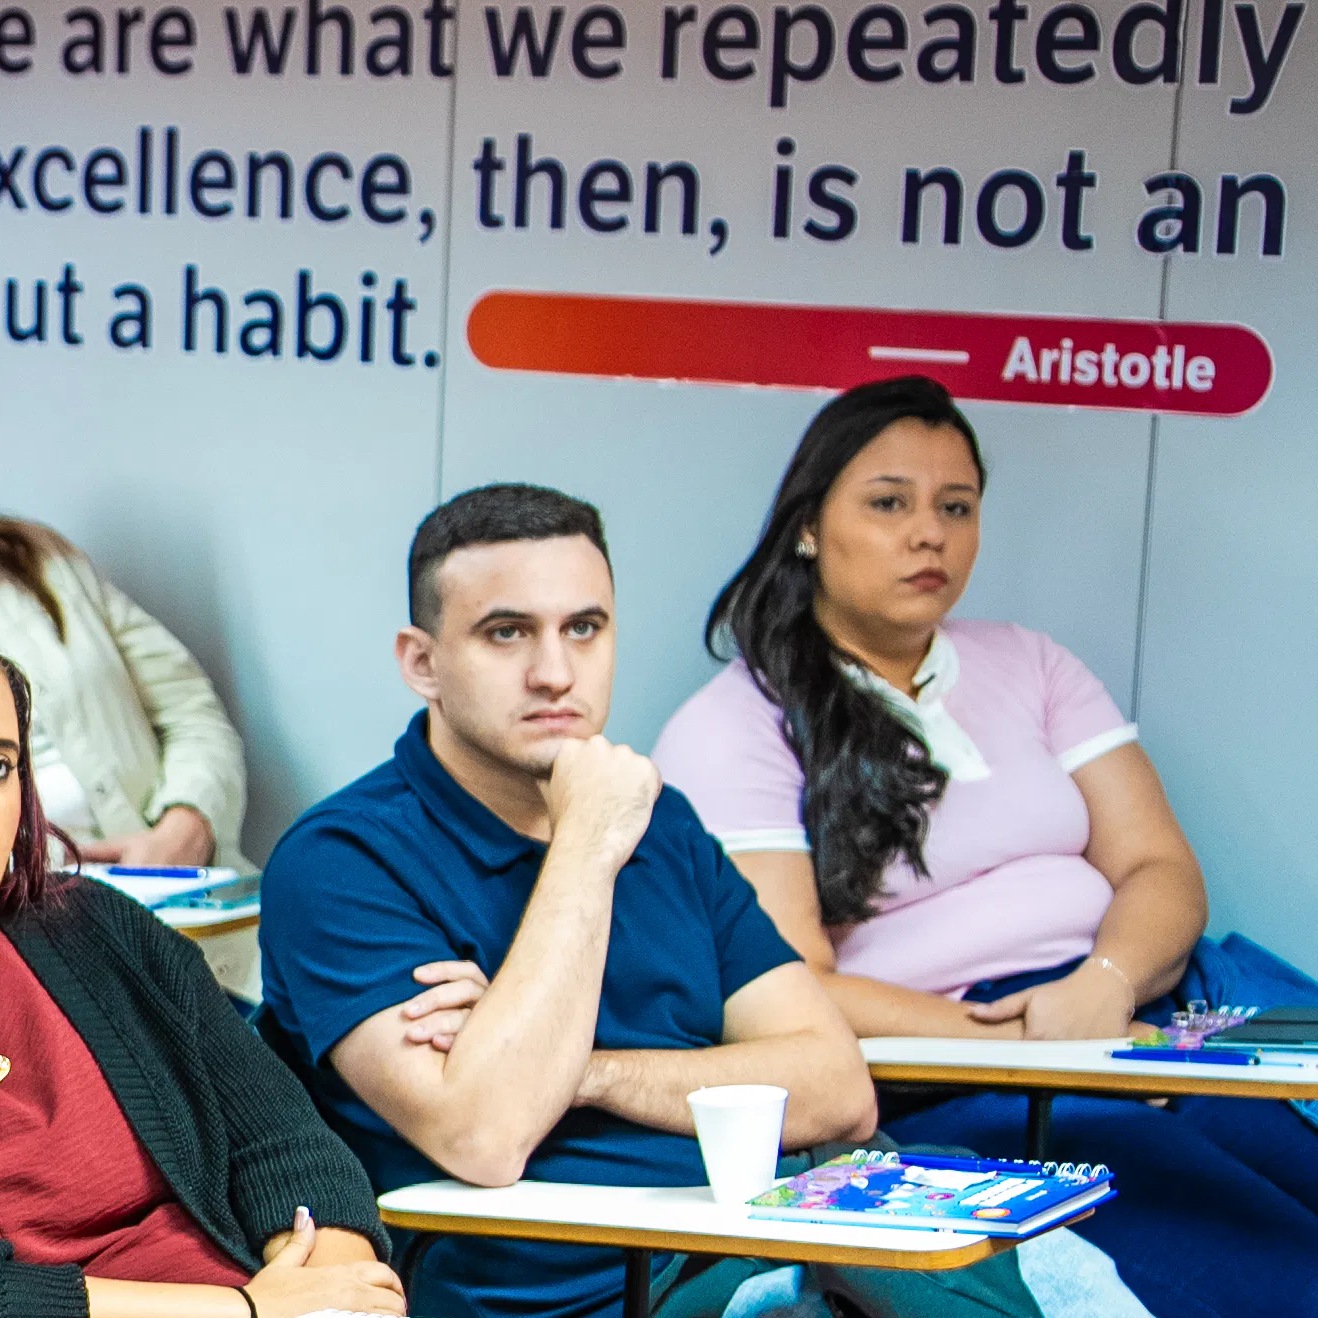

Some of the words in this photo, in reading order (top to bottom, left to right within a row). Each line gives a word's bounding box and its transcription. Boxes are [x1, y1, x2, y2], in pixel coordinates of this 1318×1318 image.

[60, 4, 198, 78] are
[222, 0, 459, 80] what
[483, 3, 629, 82] we
[659, 0, 1308, 116] repeatedly
[471, 131, 730, 257] then,
[771, 136, 859, 244] is
[899, 148, 1098, 253] not
[1134, 171, 1288, 259] an
[108, 282, 153, 351] a
[180, 262, 441, 370] habit.
[1001, 335, 1217, 393] Aristotle
